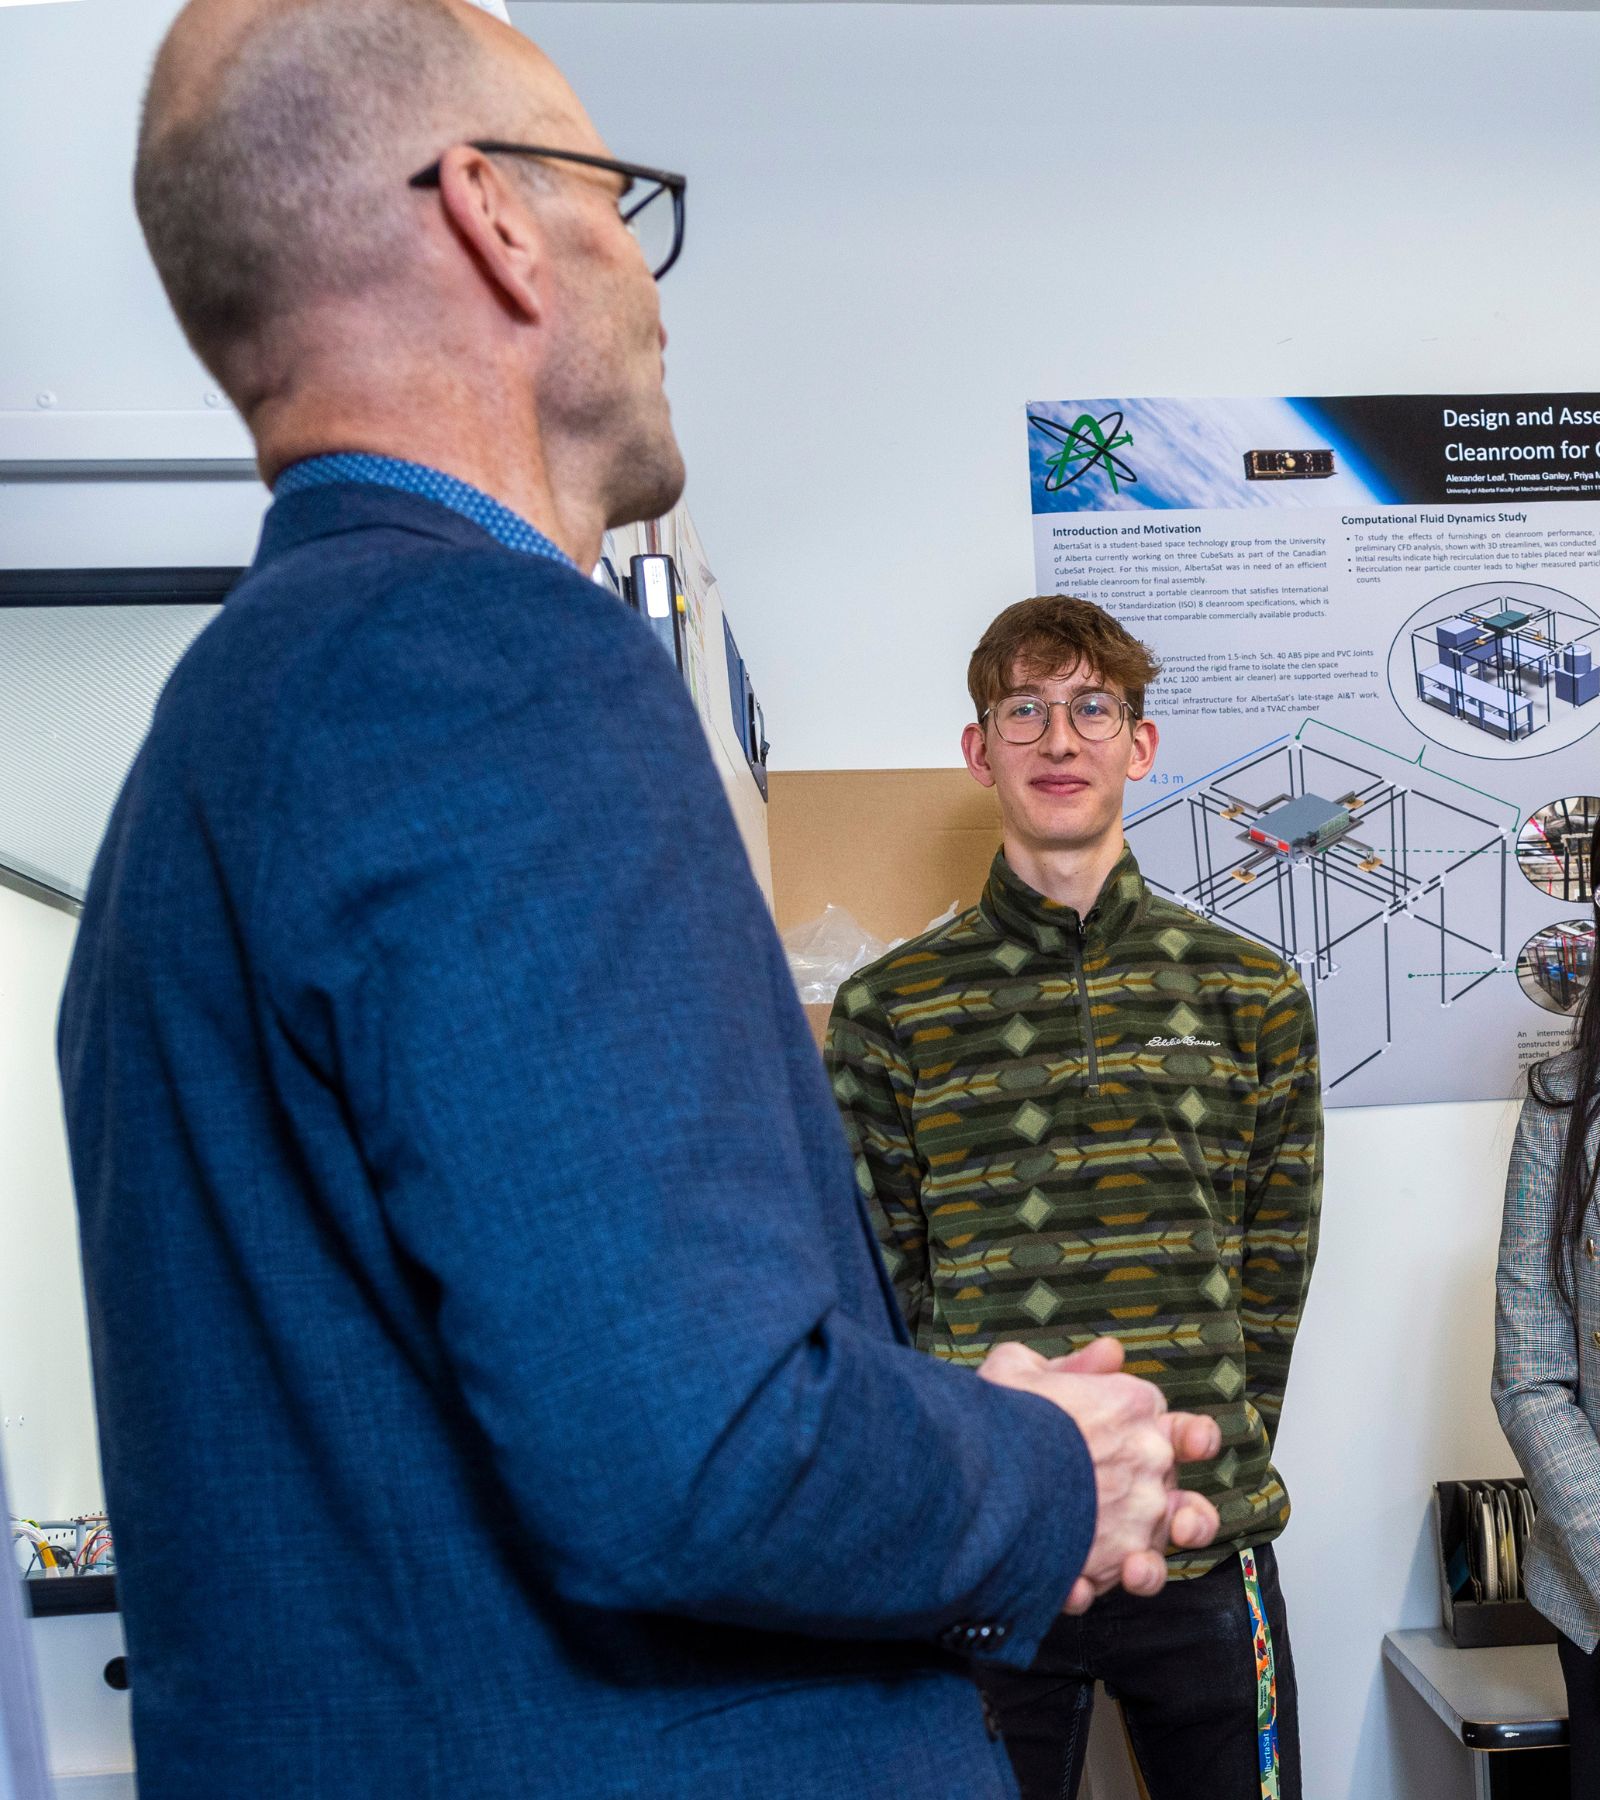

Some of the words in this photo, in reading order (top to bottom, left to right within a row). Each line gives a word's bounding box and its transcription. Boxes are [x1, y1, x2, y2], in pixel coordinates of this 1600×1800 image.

[1443, 408, 1510, 430] Design
[1516, 408, 1553, 426] and
[1444, 442, 1554, 461] Cleanroom
[1560, 441, 1589, 459] for
[1445, 473, 1485, 482] Alexander
[1486, 472, 1508, 482] Leaf,
[1508, 472, 1540, 481] Thomas
[1573, 470, 1594, 481] Priya
[1341, 514, 1417, 526] Computational
[1420, 514, 1444, 523] Fluid
[1446, 513, 1495, 524] Dynamics
[1498, 512, 1526, 524] Study
[1052, 526, 1118, 536] Introduction
[1121, 526, 1140, 535] and
[1143, 525, 1201, 534] Motivation
[1367, 533, 1387, 542] study
[1448, 531, 1487, 541] furnishings
[1547, 529, 1596, 539] performance,
[1187, 540, 1228, 549] technology
[1289, 538, 1325, 547] University
[1354, 543, 1396, 553] preliminary
[1413, 543, 1442, 552] analysis,
[1498, 541, 1543, 549] streamlines,
[1095, 554, 1128, 563] currently
[1131, 553, 1161, 562] working
[1248, 552, 1263, 560] part
[1201, 674, 1231, 682] ambient
[1246, 672, 1276, 683] cleaner)
[1293, 671, 1331, 682] supported
[1333, 670, 1368, 678] overhead
[1154, 697, 1178, 705] critical
[1182, 695, 1232, 704] infrastructure
[1297, 692, 1333, 703] late-stage
[1359, 691, 1380, 700] work,
[1150, 774, 1168, 784] 4.3
[1518, 1040, 1560, 1048] constructed
